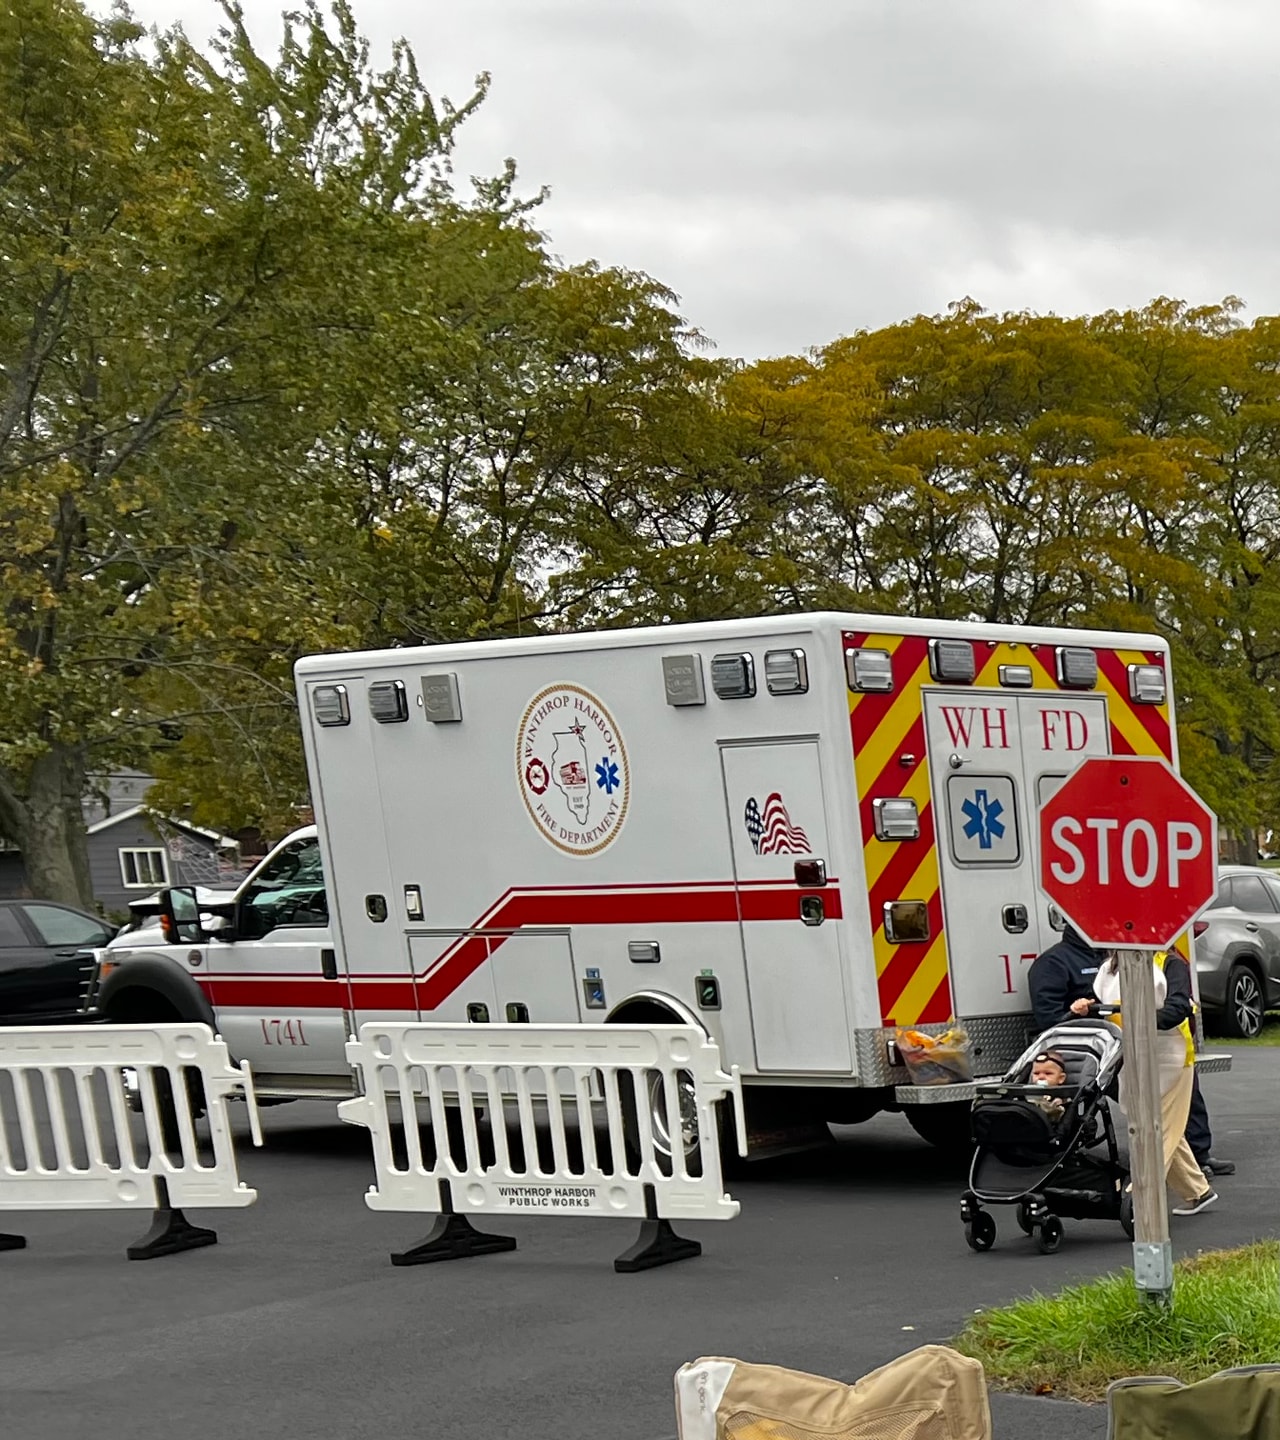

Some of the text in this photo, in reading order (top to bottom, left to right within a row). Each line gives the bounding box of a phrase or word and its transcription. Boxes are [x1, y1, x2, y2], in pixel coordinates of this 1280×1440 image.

[524, 695, 570, 758] WINTHROP
[574, 697, 617, 756] HARBOR
[939, 706, 1088, 751] WH FD
[536, 799, 619, 845] FIRE DEPARTMENT
[1051, 816, 1203, 889] STOP
[260, 1018, 310, 1046] 1741
[498, 1187, 596, 1198] WINTHROP HARBOR
[508, 1197, 590, 1207] PUBLIC WORKS
